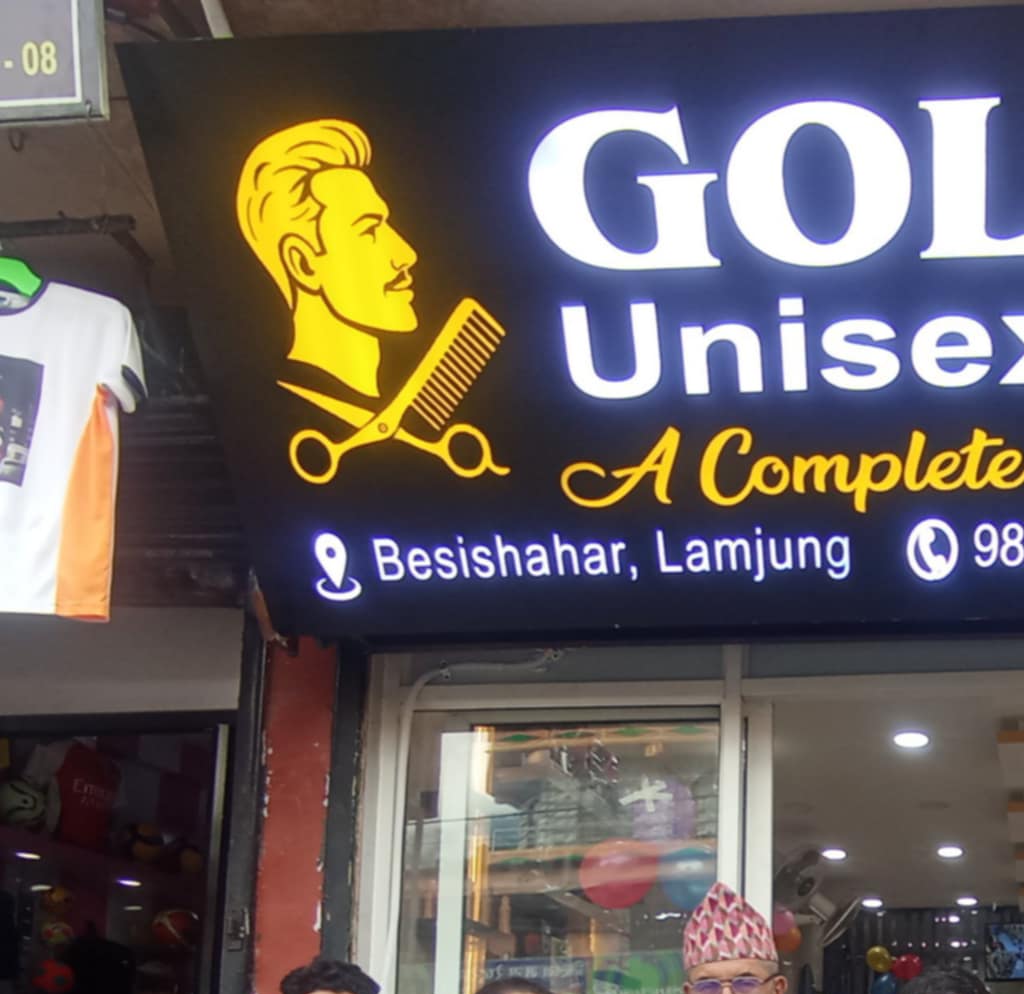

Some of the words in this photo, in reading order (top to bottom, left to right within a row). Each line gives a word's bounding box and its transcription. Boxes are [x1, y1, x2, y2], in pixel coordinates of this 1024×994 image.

[21, 40, 58, 76] 08
[560, 425, 682, 509] A
[373, 533, 637, 582] Besishahar,
[656, 527, 851, 582] Lamjung
